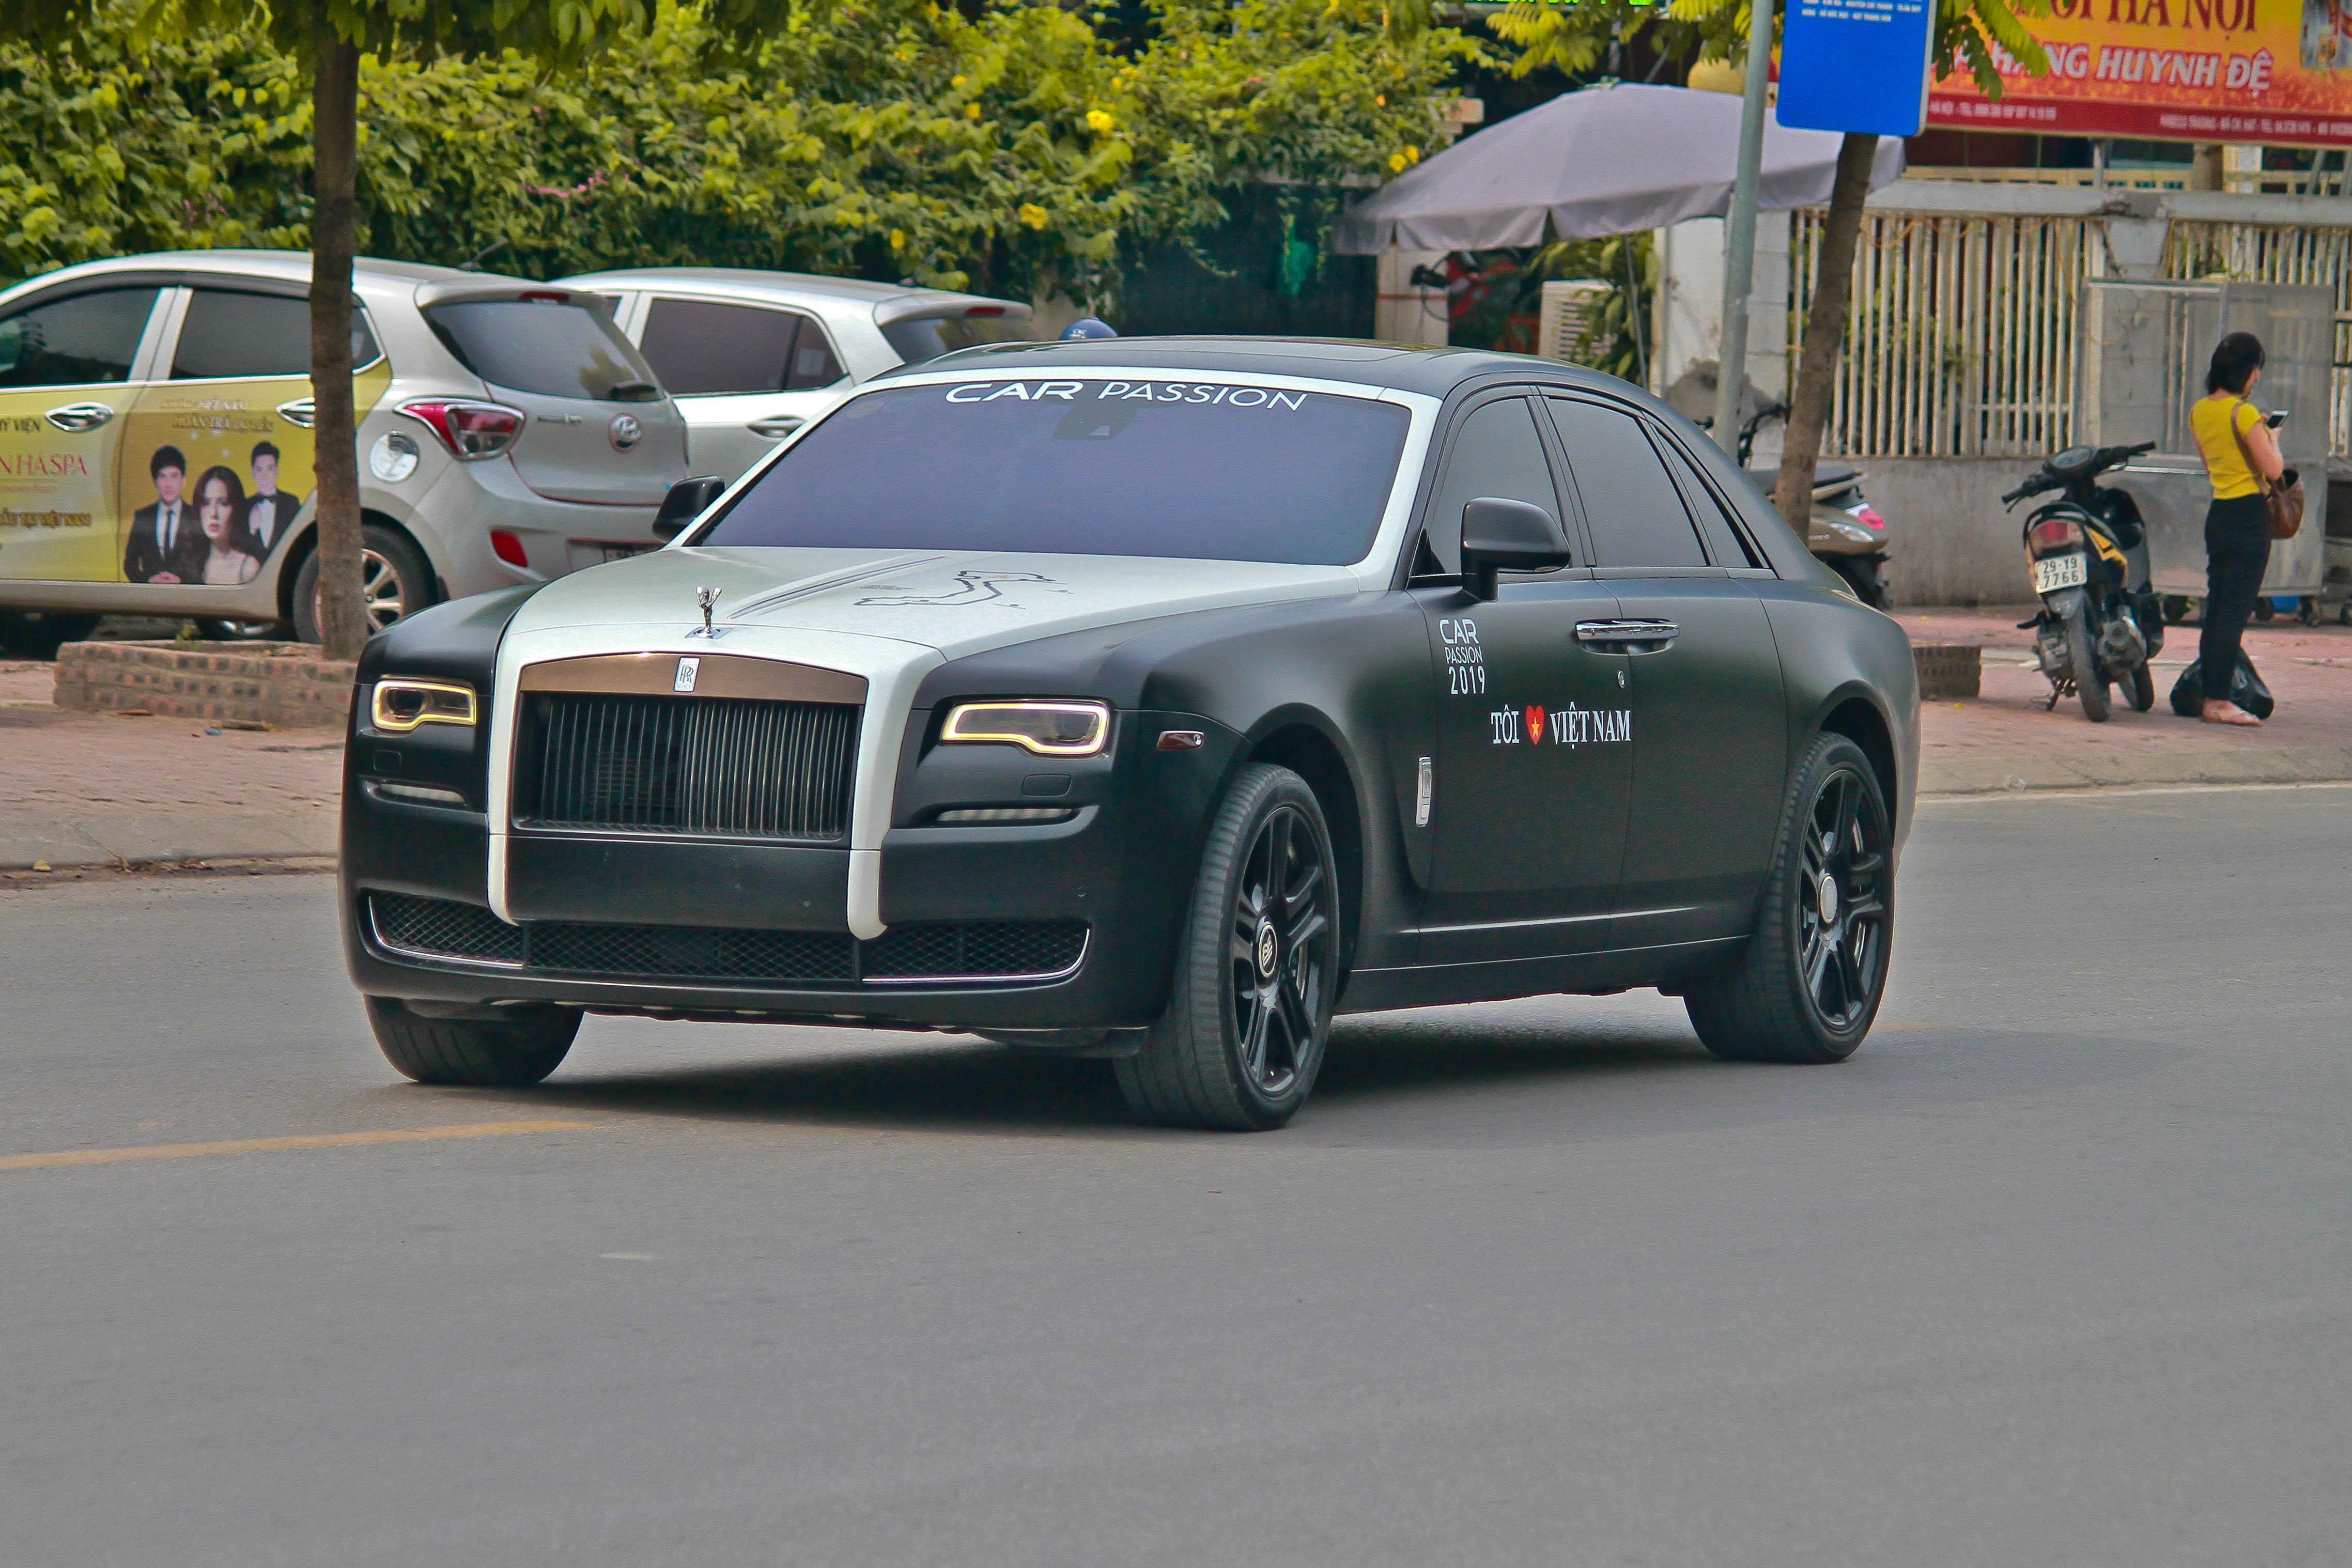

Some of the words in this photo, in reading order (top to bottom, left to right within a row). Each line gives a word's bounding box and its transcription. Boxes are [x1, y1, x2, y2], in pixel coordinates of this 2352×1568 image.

[2096, 48, 2221, 87] HUYNH
[2225, 49, 2272, 97] ĐỆ
[945, 381, 1084, 403] CAR
[1097, 381, 1307, 411] PASSION
[1439, 618, 1480, 645] CAR
[1444, 646, 1483, 664] PASSION
[1448, 665, 1486, 695] 2019
[1491, 704, 1520, 744] TÔI
[1550, 701, 1590, 750] VIỆT
[1593, 709, 1631, 742] NAM
